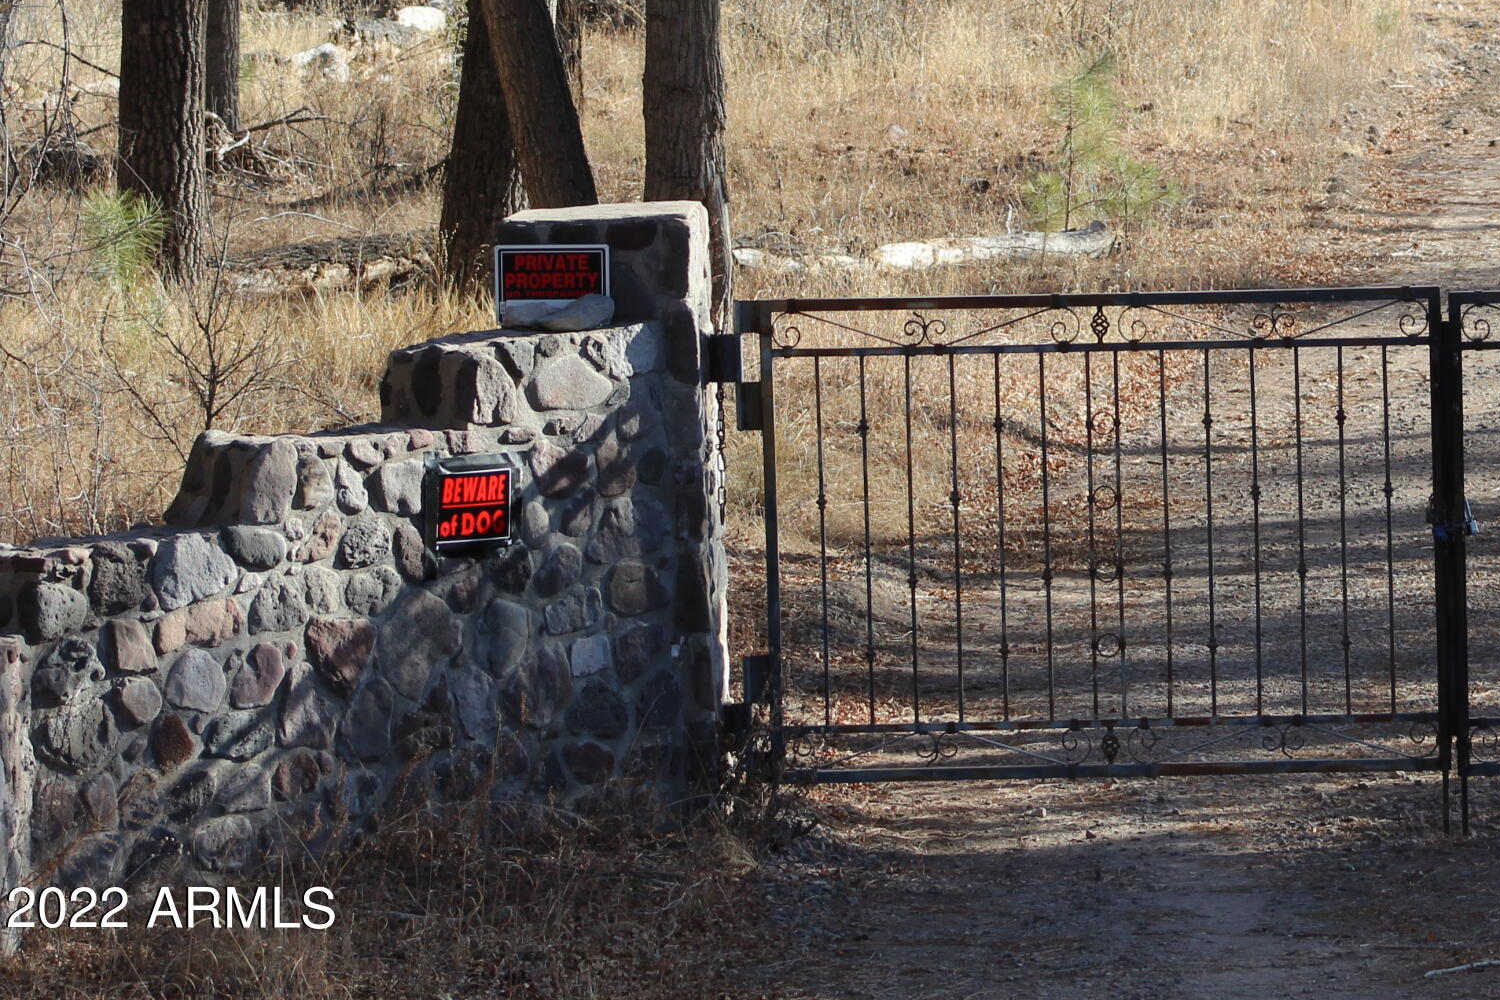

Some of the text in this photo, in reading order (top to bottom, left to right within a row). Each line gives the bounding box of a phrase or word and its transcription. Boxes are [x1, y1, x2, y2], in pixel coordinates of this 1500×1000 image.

[514, 254, 589, 271] PRIVATE
[504, 272, 599, 289] PROPERTY
[442, 473, 507, 504] BEWARE
[439, 509, 505, 538] of DOG
